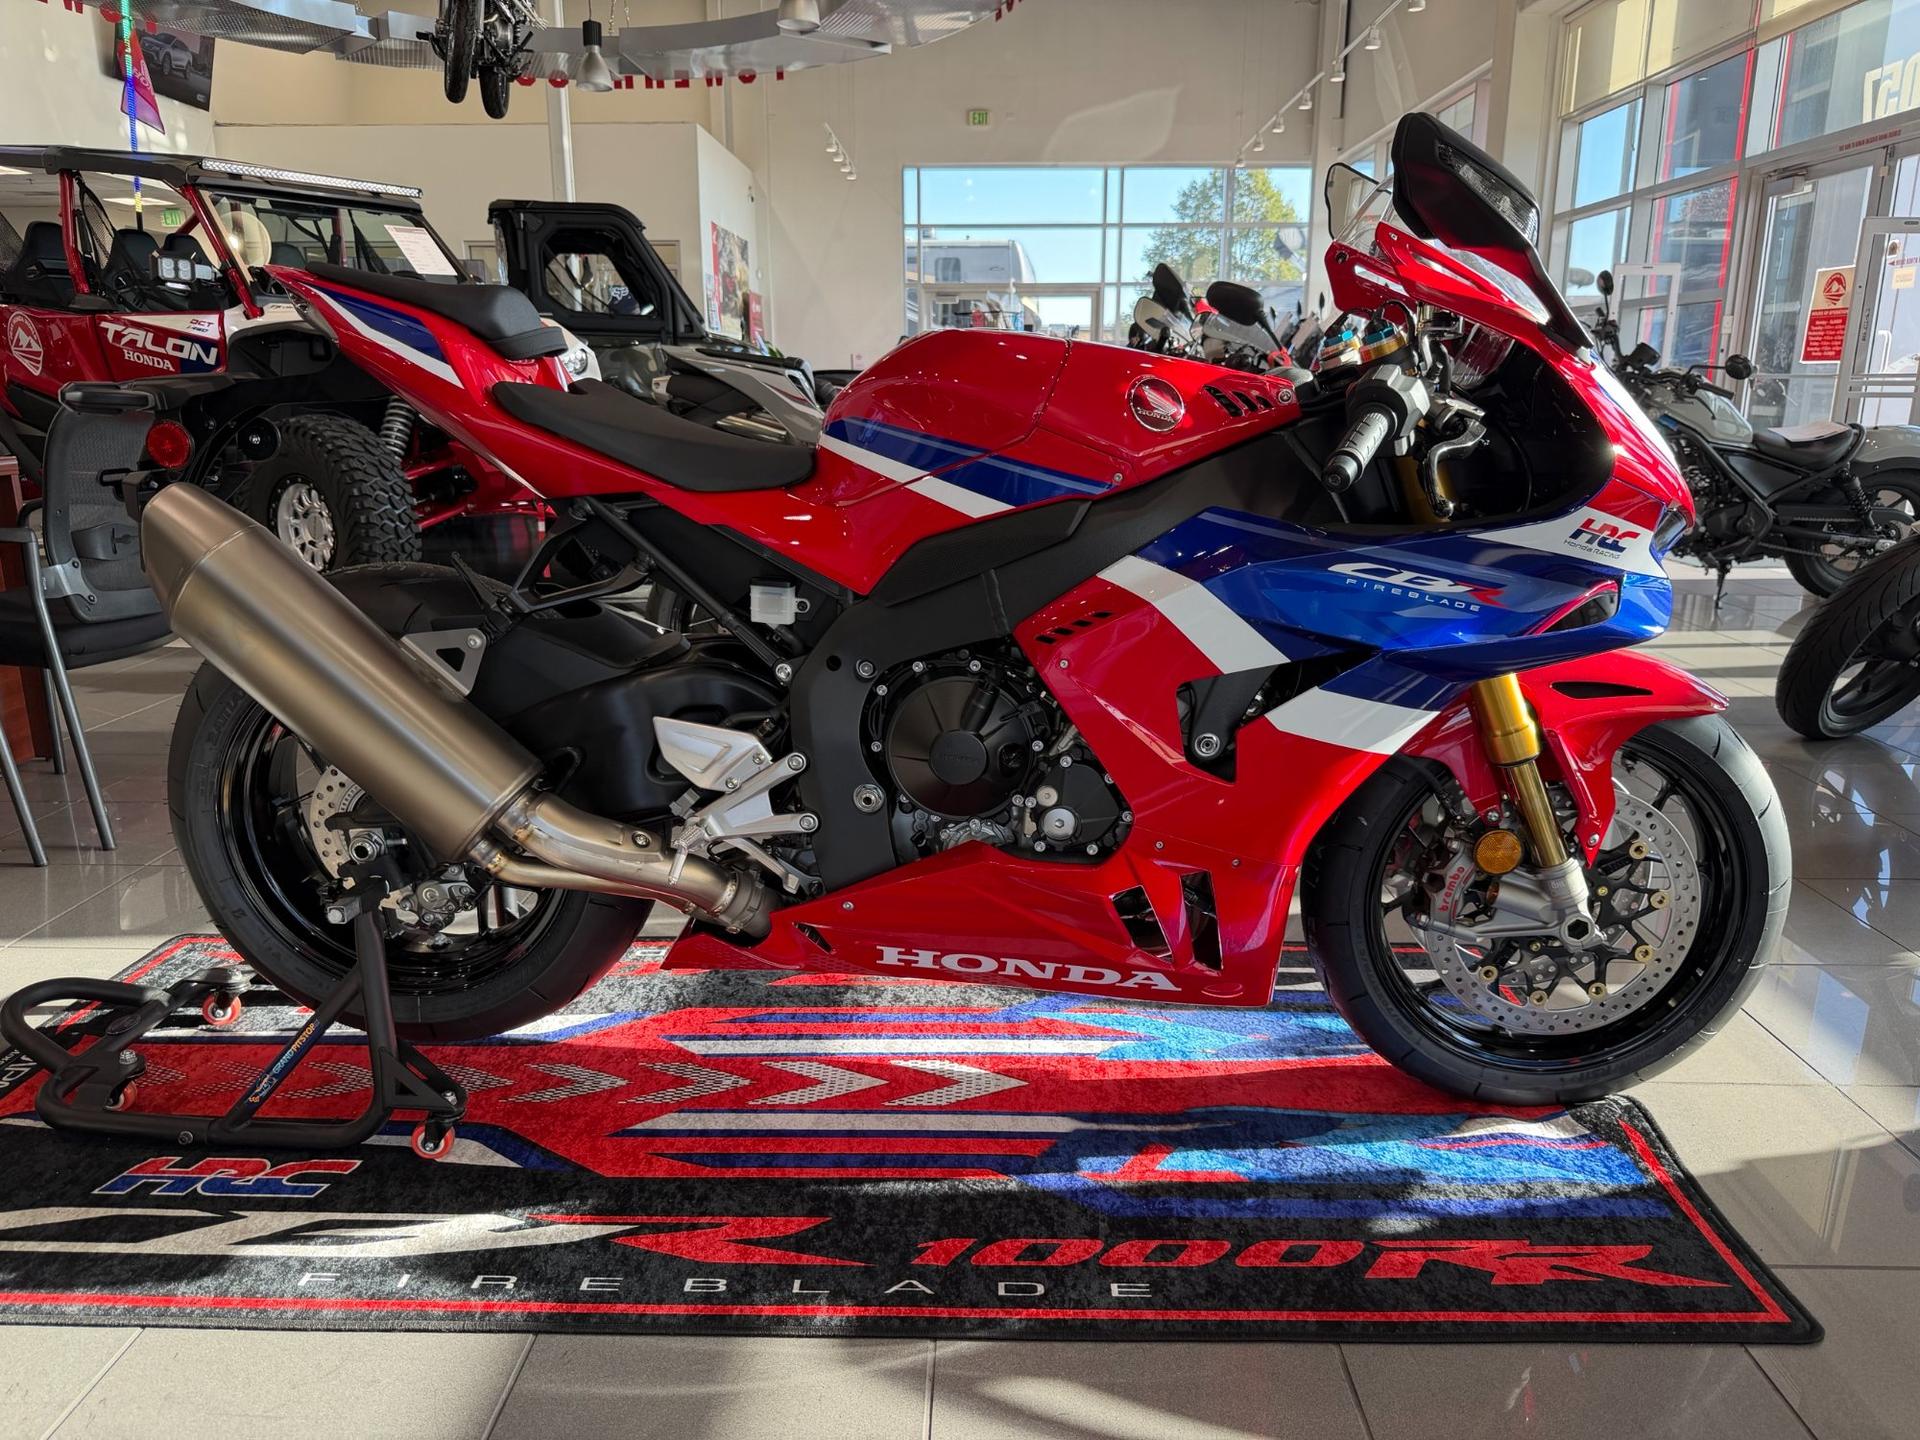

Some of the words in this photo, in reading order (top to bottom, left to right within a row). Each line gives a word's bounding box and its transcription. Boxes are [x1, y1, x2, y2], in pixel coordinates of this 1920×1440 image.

[972, 111, 988, 126] EXIT
[100, 320, 218, 365] TALON
[124, 349, 176, 372] HONDA
[1137, 409, 1175, 423] HONDA
[1568, 517, 1641, 553] HRC
[1327, 562, 1509, 609] CBR
[1345, 578, 1480, 612] FIREBLADE
[1438, 866, 1465, 912] brembo
[876, 945, 1182, 991] HONDA
[91, 1156, 362, 1198] HRC
[910, 1239, 1733, 1288] 1000RR
[298, 1272, 1153, 1299] FIREBLADE
